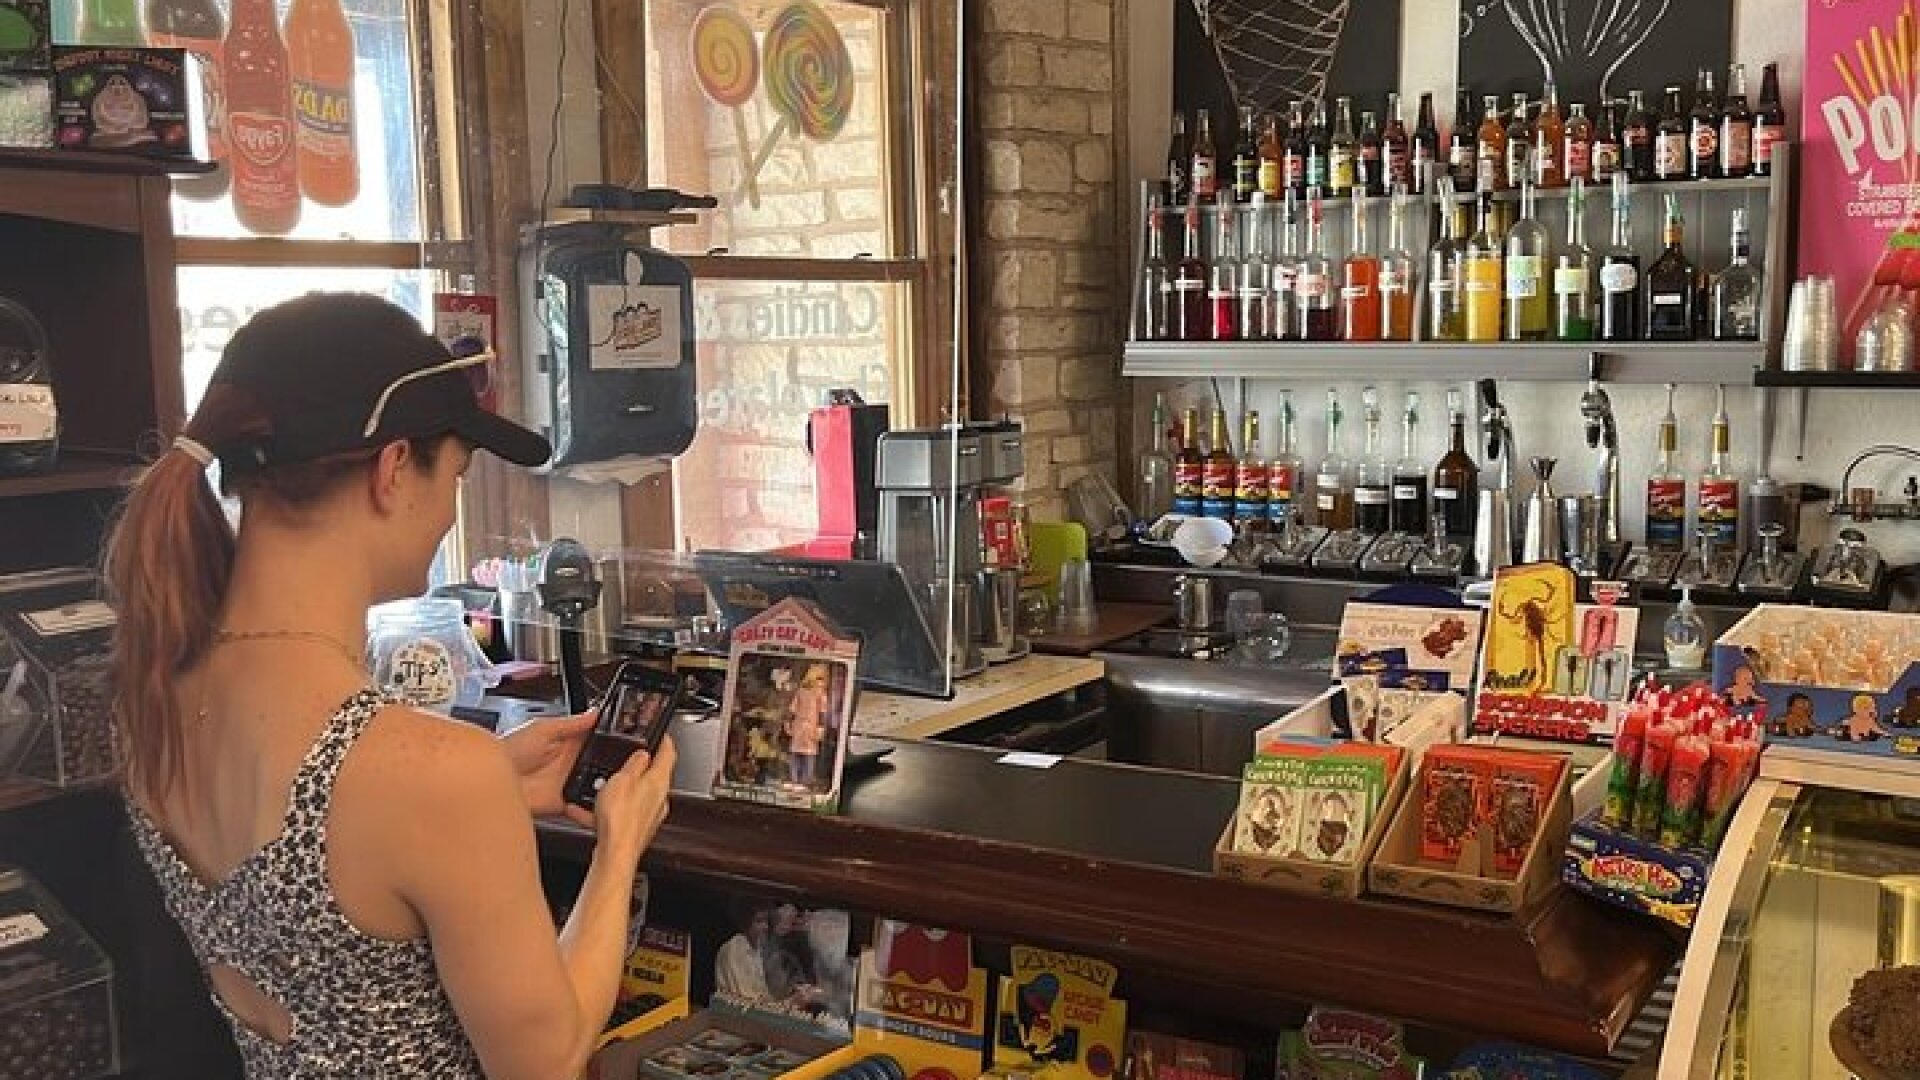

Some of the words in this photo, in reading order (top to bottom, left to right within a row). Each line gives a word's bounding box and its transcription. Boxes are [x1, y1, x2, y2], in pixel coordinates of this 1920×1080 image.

[1478, 692, 1608, 723] SCORPION
[1471, 712, 1590, 742] SUCKERS
[869, 981, 967, 1021] PAC-MAN
